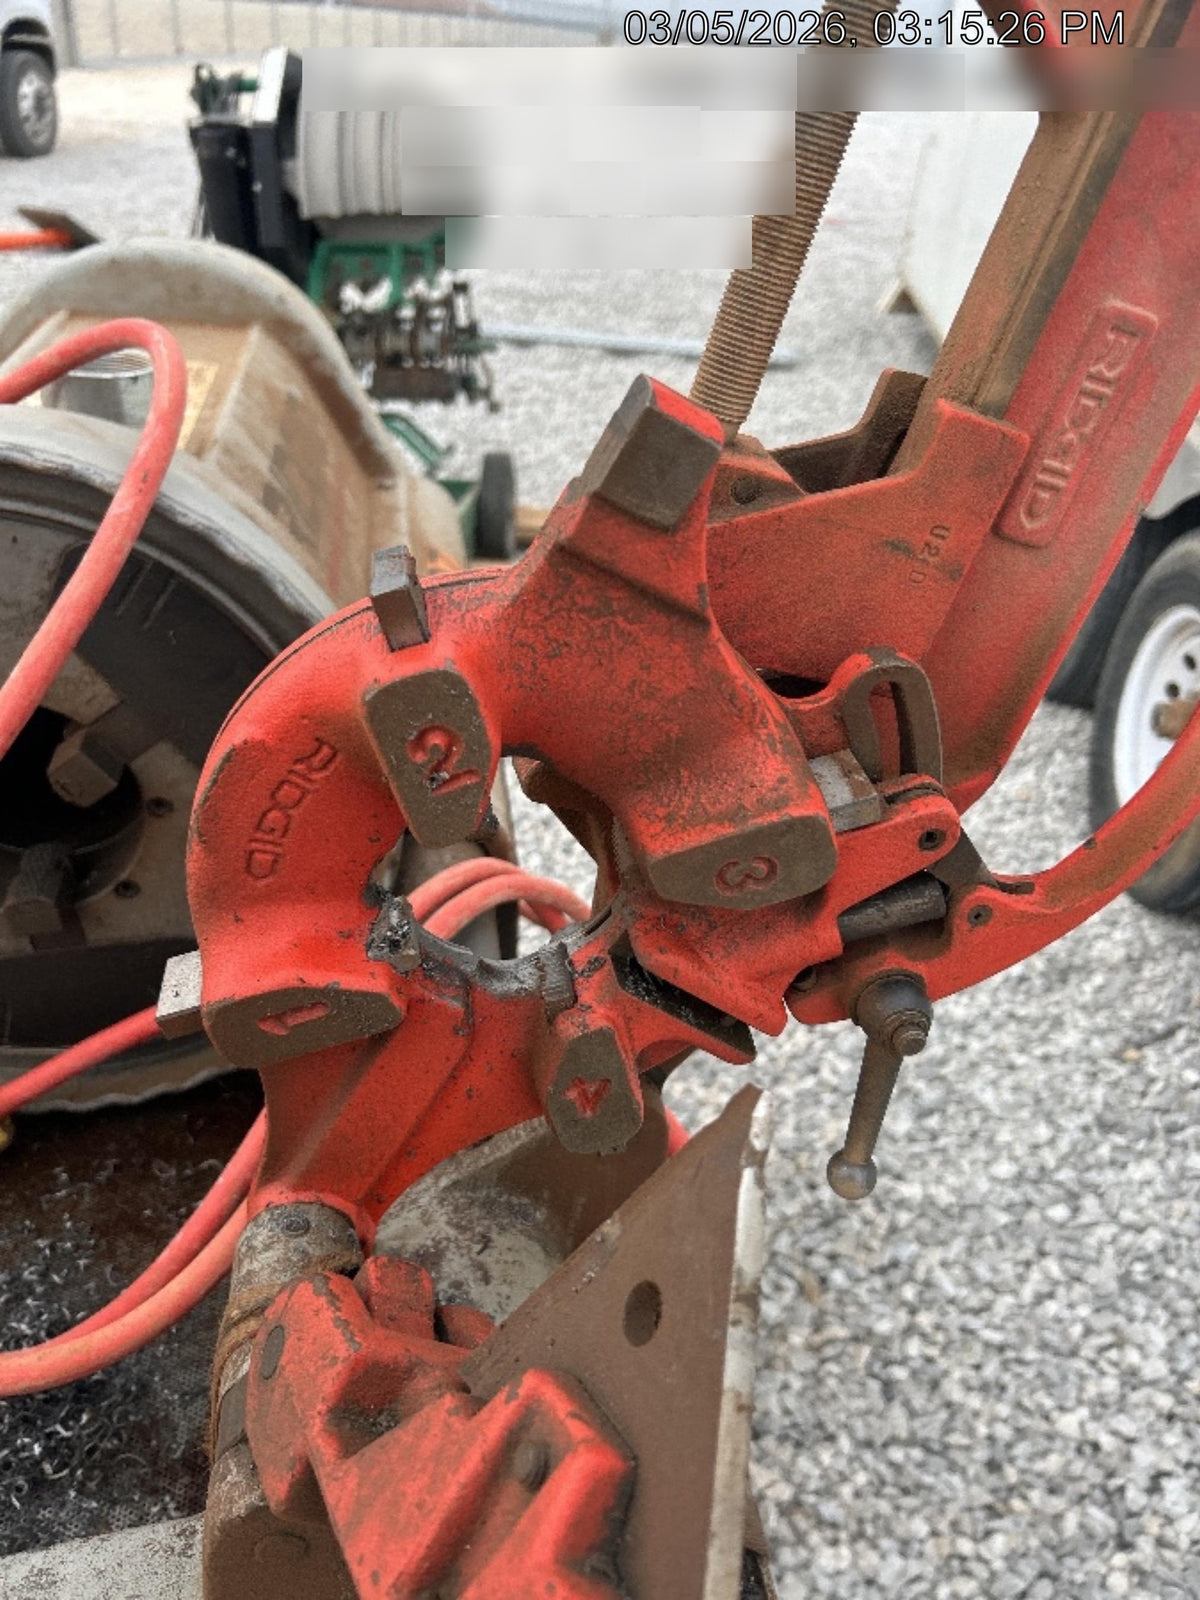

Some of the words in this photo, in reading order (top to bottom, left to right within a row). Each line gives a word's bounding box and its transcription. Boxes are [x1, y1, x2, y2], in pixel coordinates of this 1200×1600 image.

[1020, 324, 1141, 529] RIDGID
[407, 724, 481, 796] 2
[244, 737, 338, 880] RIDGID
[715, 856, 779, 897] 3
[257, 1002, 331, 1036] 1
